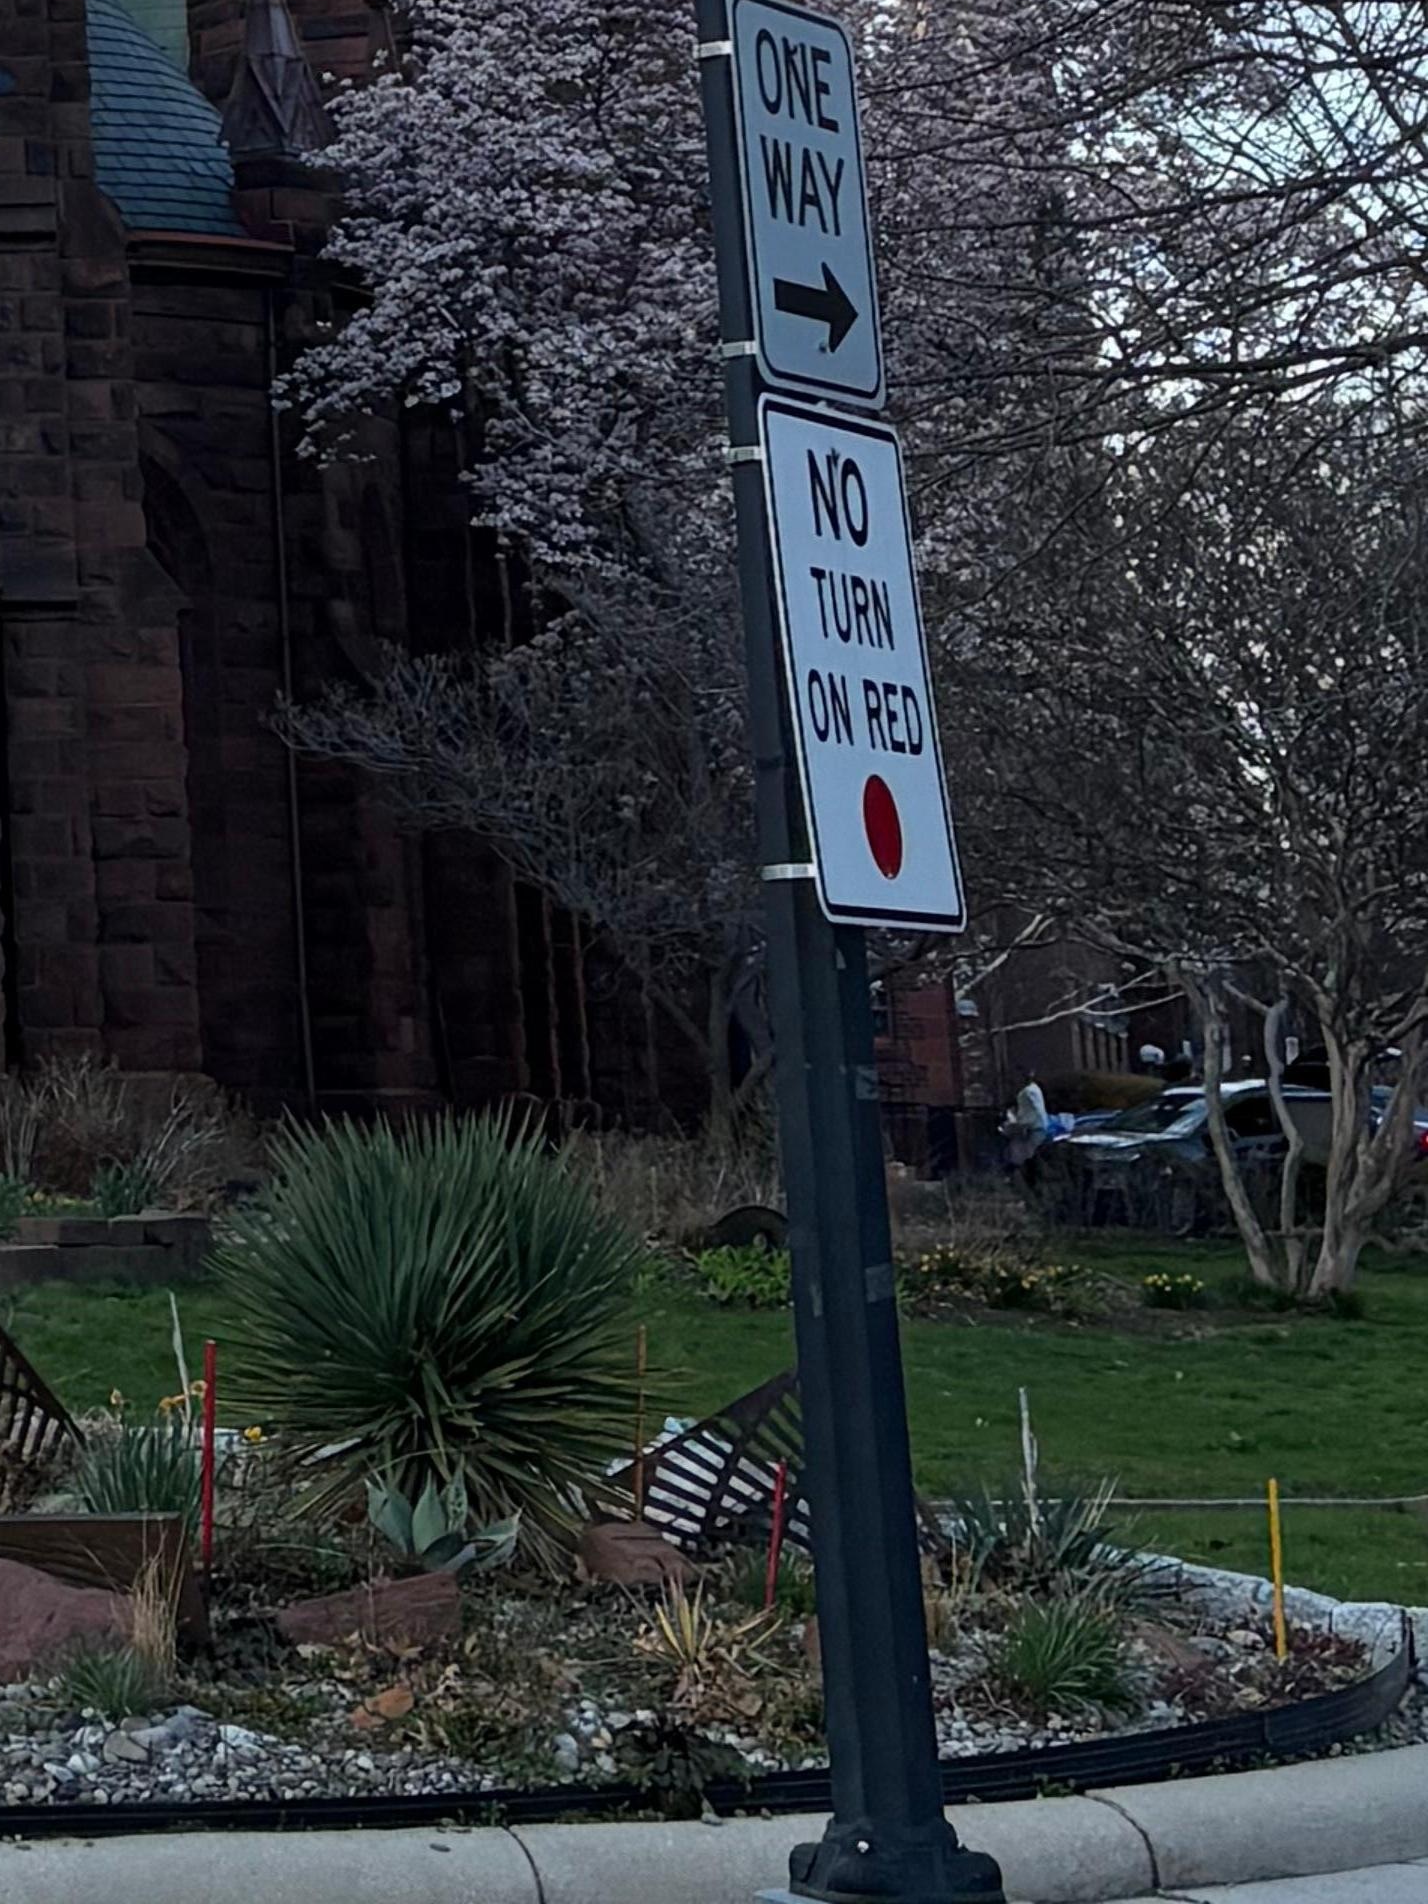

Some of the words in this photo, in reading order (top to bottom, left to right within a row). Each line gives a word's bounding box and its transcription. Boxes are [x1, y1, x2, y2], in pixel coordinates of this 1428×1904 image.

[755, 27, 840, 133] ONE
[758, 133, 844, 237] WAY
[806, 448, 870, 548] NO
[809, 566, 896, 652] TURN
[806, 668, 855, 748] ON
[862, 677, 924, 757] RED
